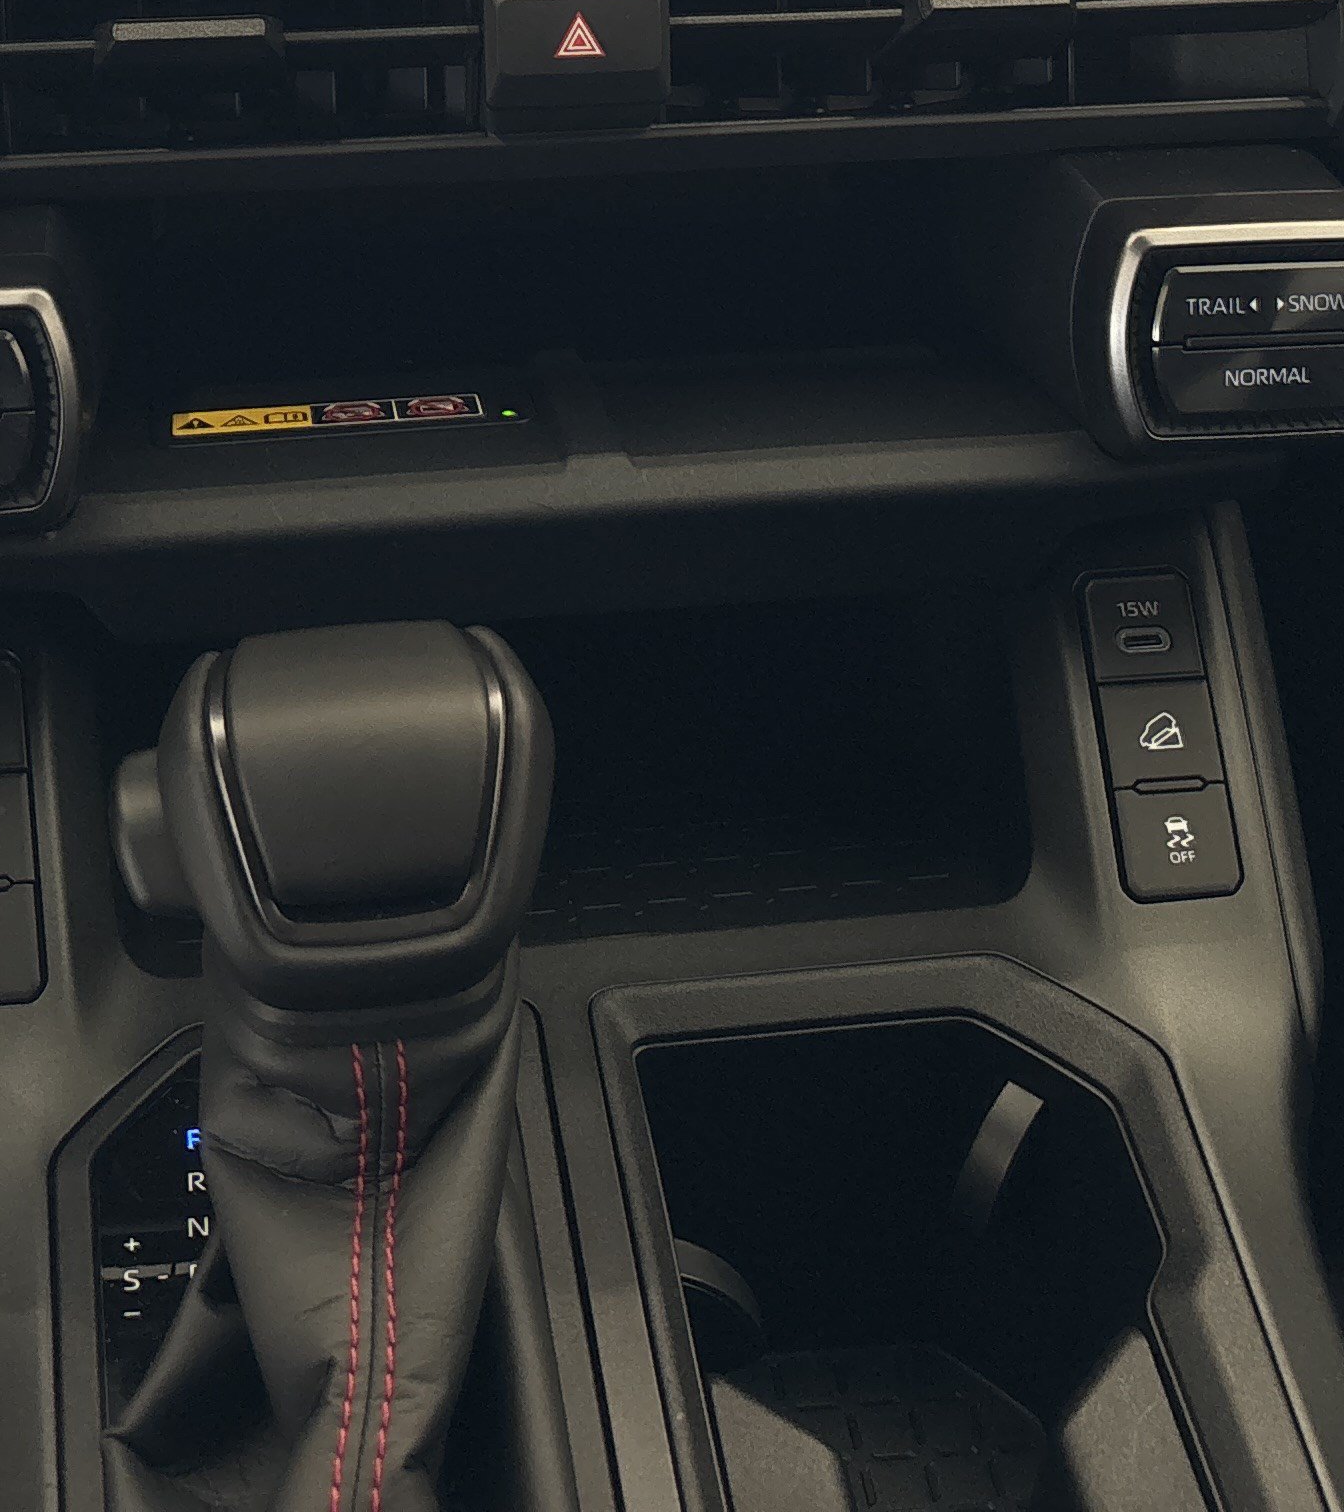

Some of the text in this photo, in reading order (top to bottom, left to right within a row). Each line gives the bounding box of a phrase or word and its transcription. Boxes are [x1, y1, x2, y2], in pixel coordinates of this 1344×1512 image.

[1186, 298, 1246, 315] TRAIL
[1224, 368, 1310, 387] NORMAL
[1117, 601, 1160, 617] 15W
[1170, 851, 1196, 864] OFF
[188, 1172, 206, 1192] R
[188, 1216, 209, 1238] N
[123, 1269, 140, 1291] S
